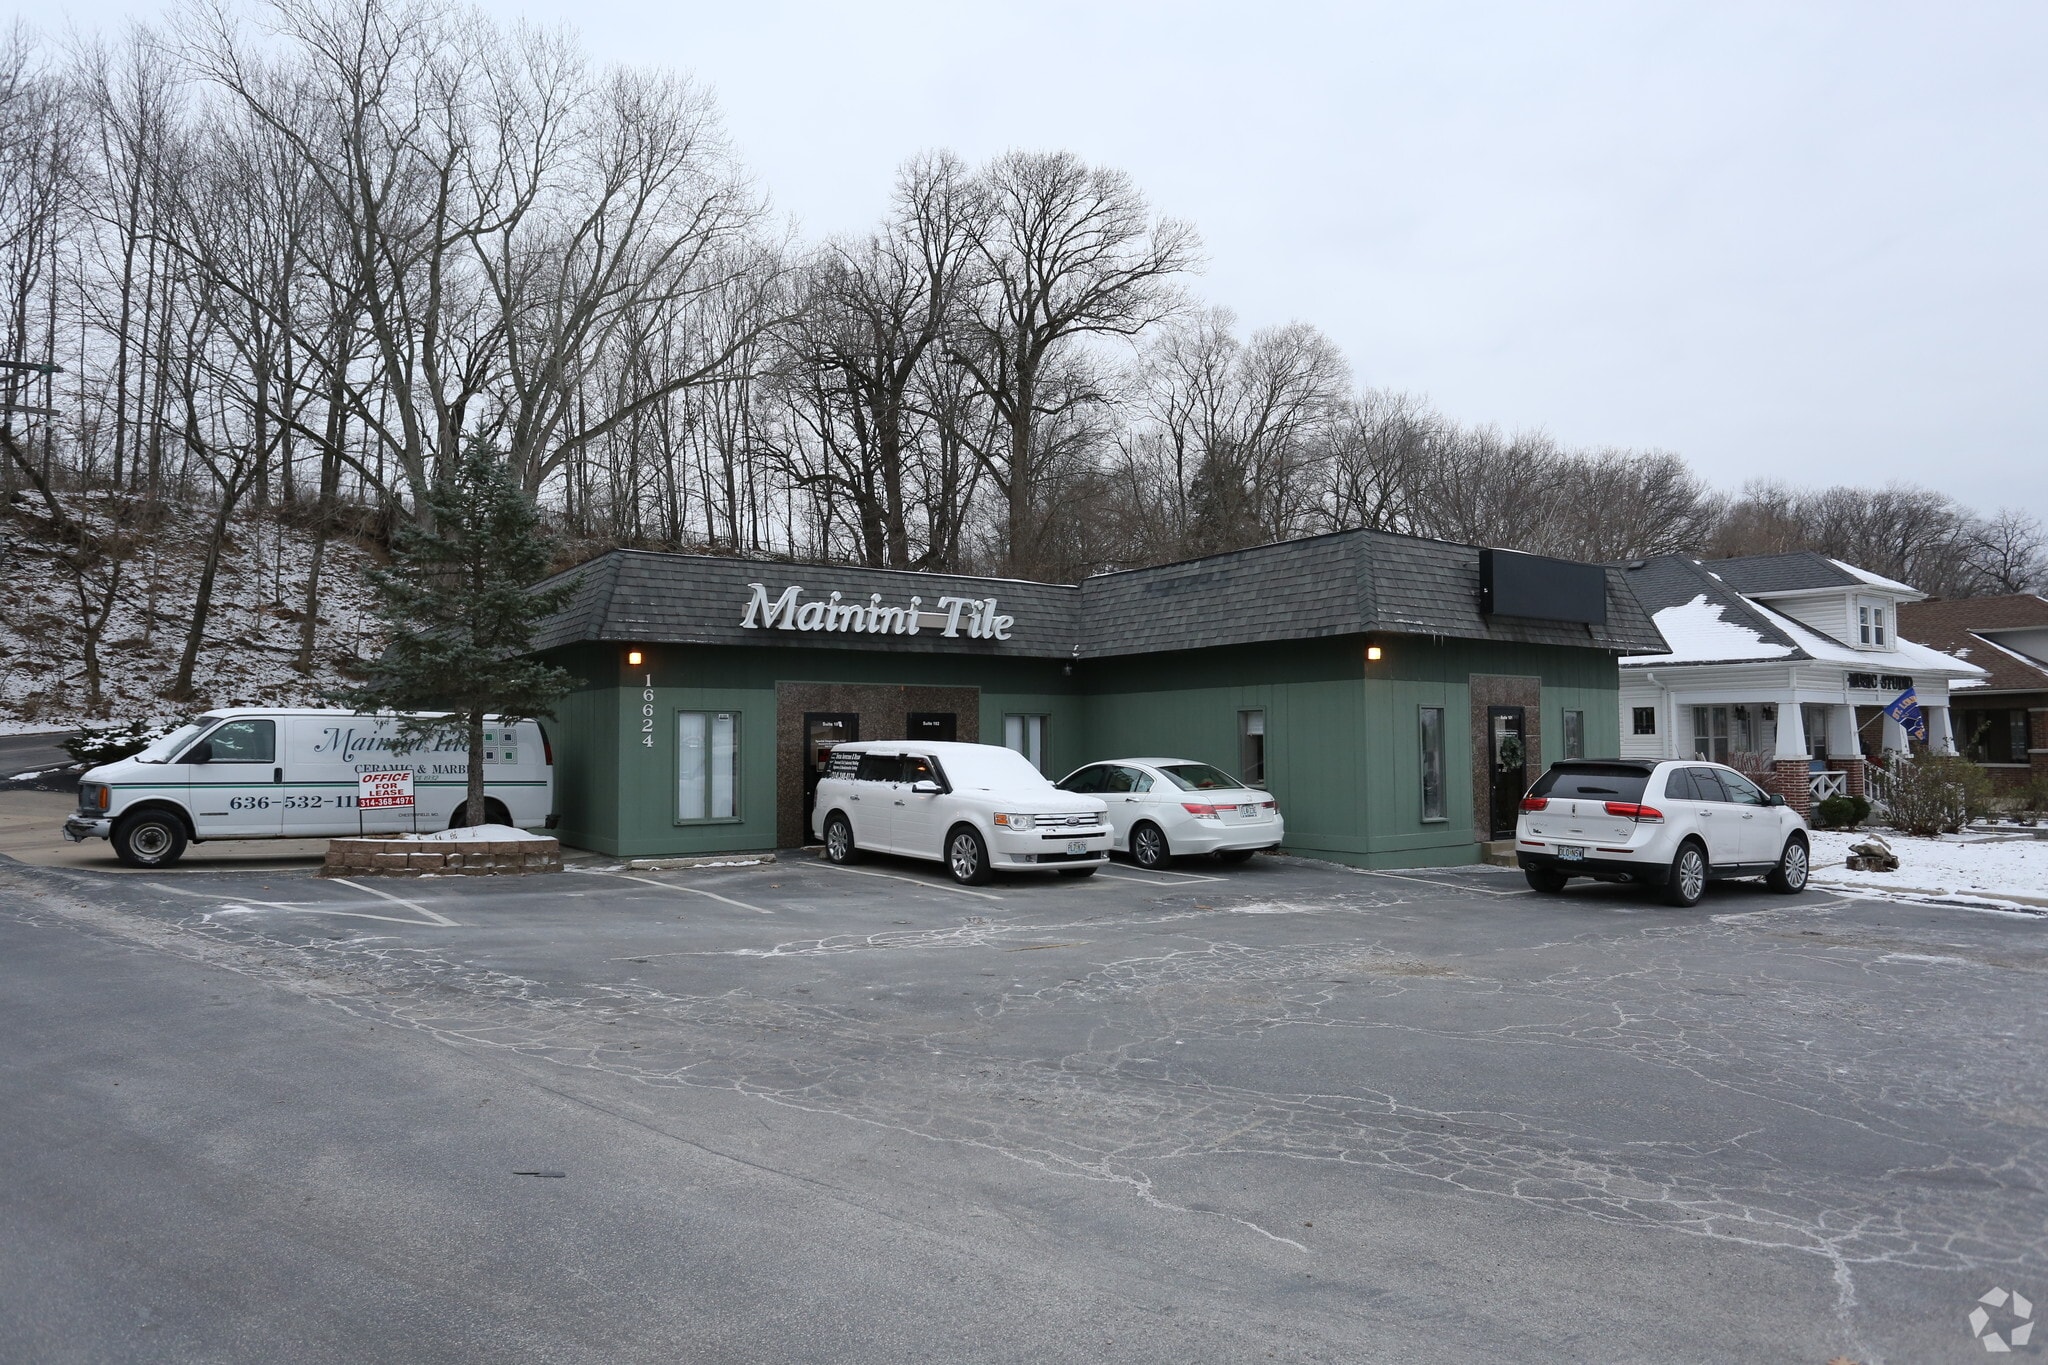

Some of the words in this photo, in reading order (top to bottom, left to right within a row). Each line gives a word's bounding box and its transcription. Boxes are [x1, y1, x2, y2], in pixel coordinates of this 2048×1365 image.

[739, 582, 922, 636] Mainini
[937, 598, 1015, 641] Tile
[1848, 673, 1877, 688] MUSIC
[1880, 676, 1913, 690] STUDIO
[641, 673, 654, 748] 16624
[417, 765, 426, 774] &
[362, 772, 410, 783] OFFICE
[369, 789, 404, 797] LEASE
[360, 796, 414, 807] 314-368-4971
